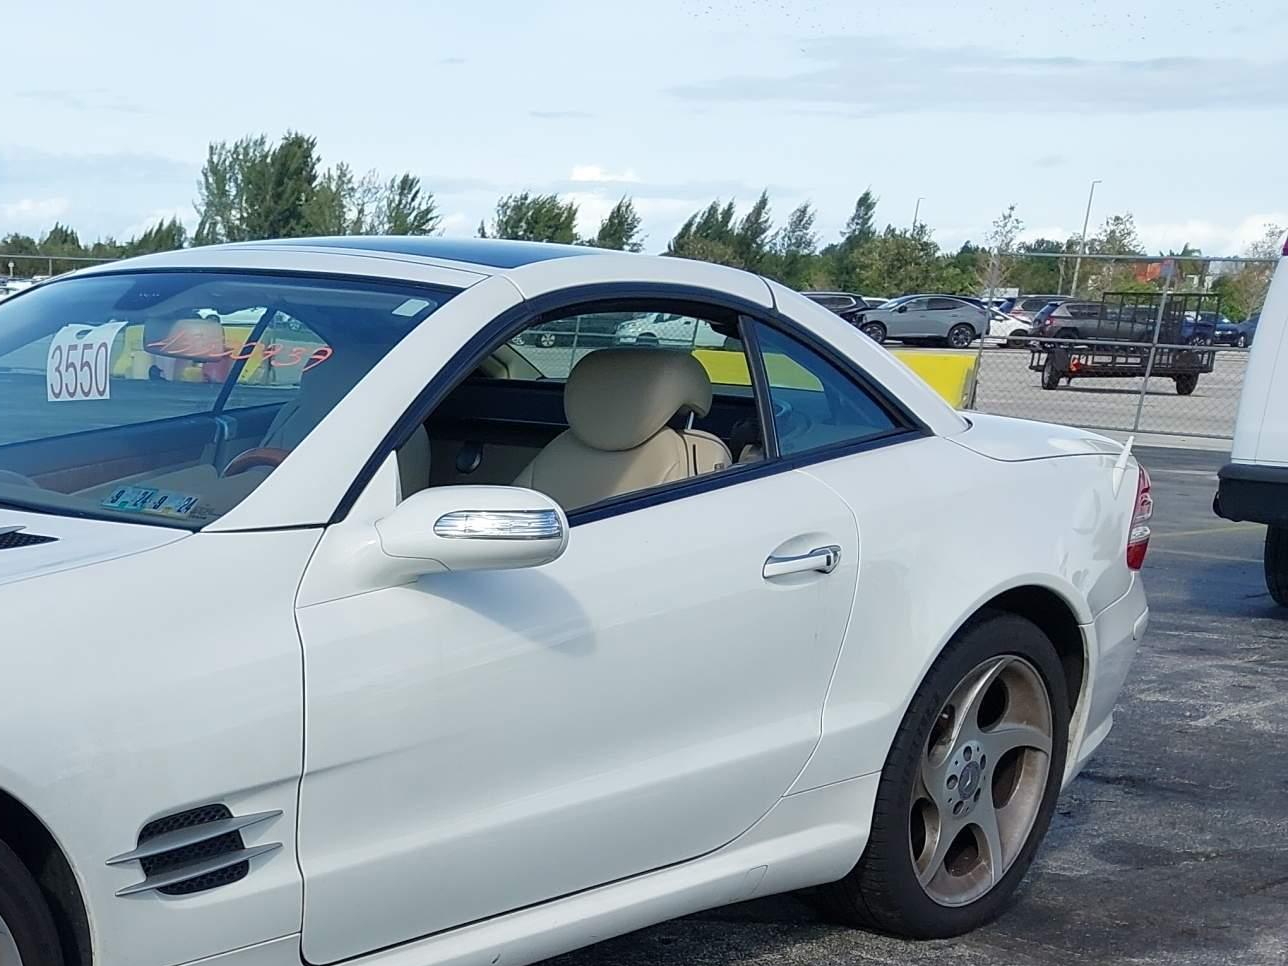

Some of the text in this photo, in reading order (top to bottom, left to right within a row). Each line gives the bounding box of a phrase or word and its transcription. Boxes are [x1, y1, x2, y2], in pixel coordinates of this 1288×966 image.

[50, 342, 108, 399] 3550
[110, 490, 125, 504] 9
[153, 496, 168, 510] 9
[177, 497, 198, 513] 24
